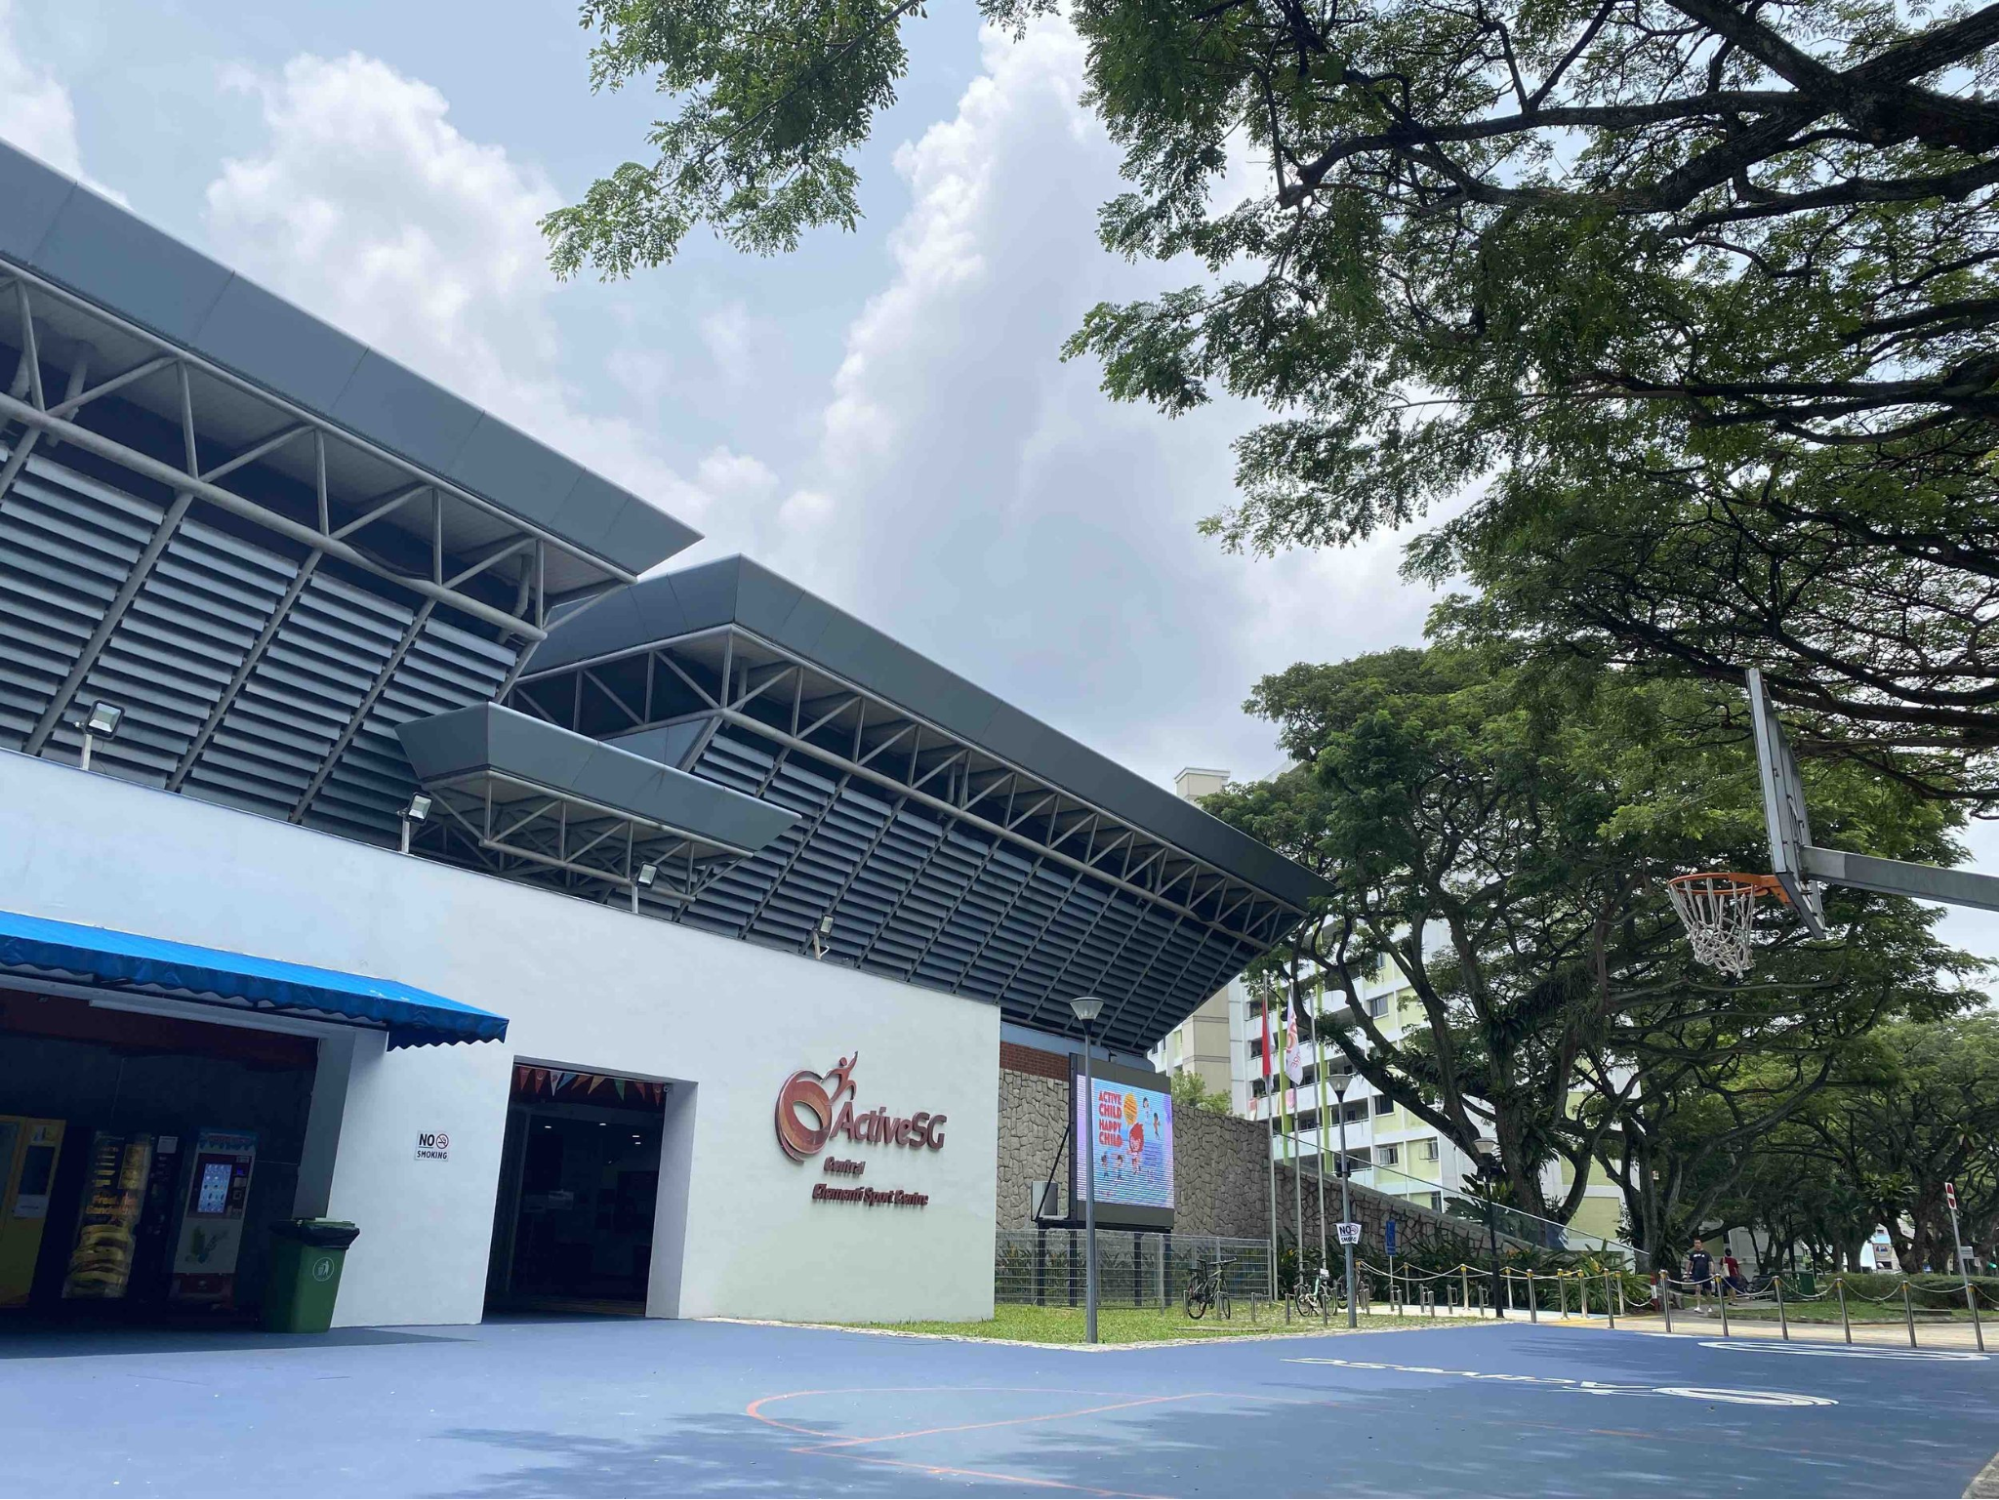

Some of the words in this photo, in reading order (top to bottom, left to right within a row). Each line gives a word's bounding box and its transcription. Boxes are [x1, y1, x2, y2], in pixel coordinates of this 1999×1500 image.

[1098, 1090, 1122, 1105] ACTIVE
[1098, 1103, 1122, 1119] CHILD
[830, 1101, 947, 1149] ActiveSG
[1098, 1118, 1122, 1133] HAPPY
[419, 1133, 435, 1146] NO
[1098, 1132, 1123, 1147] CHILD
[417, 1150, 448, 1160] SMOKING
[823, 1156, 866, 1176] Central
[812, 1183, 864, 1203] Clementi
[863, 1187, 895, 1206] Sport
[894, 1190, 929, 1206] Centre
[1338, 1225, 1352, 1235] NO
